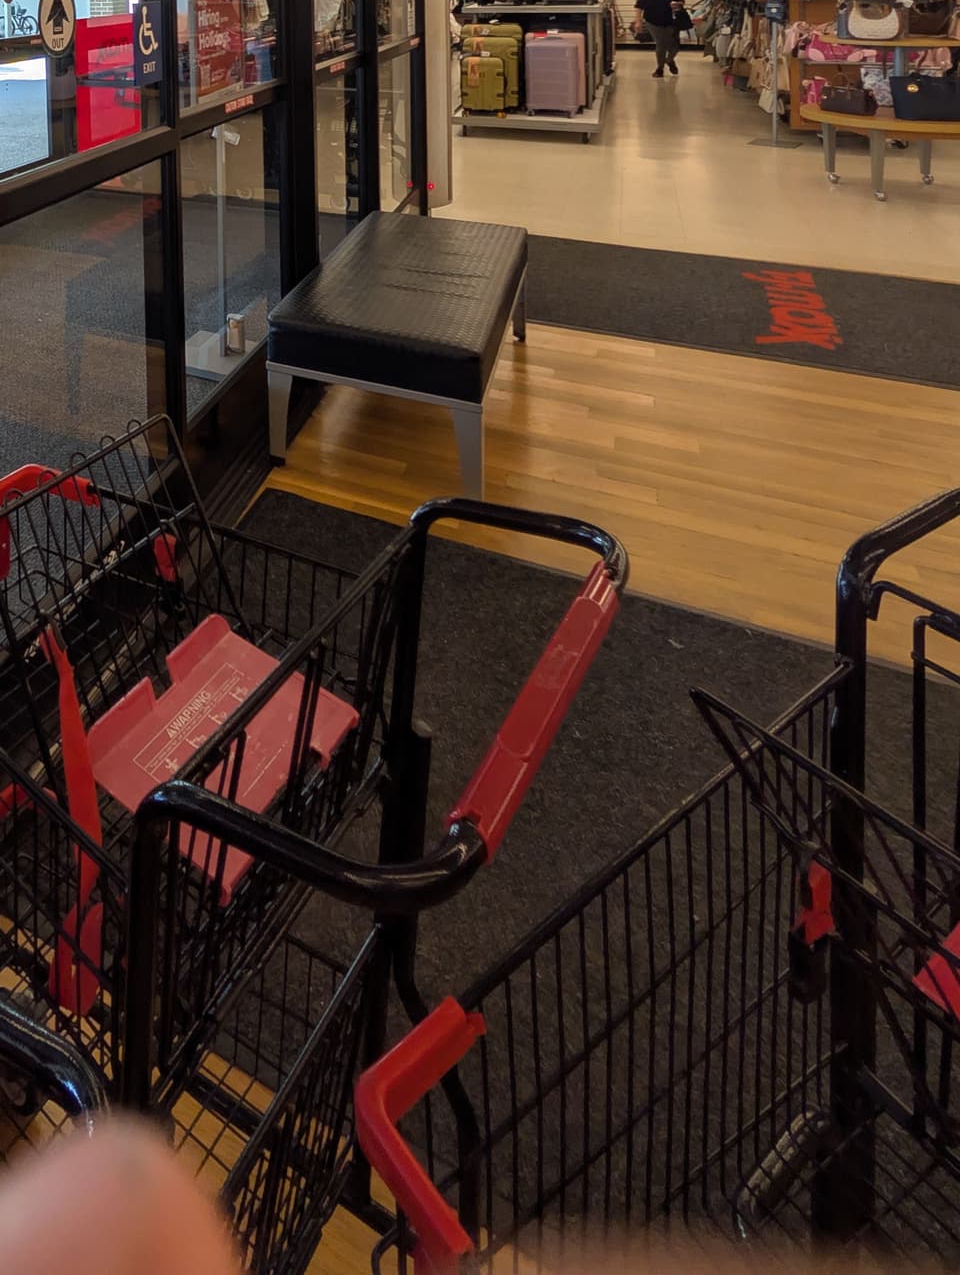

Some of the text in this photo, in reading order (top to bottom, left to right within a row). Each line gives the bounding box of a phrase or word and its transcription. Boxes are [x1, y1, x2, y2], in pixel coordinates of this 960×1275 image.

[198, 9, 220, 28] Hiring
[51, 37, 65, 49] OUT
[143, 61, 157, 74] EXIT
[171, 691, 211, 737] WARNING
